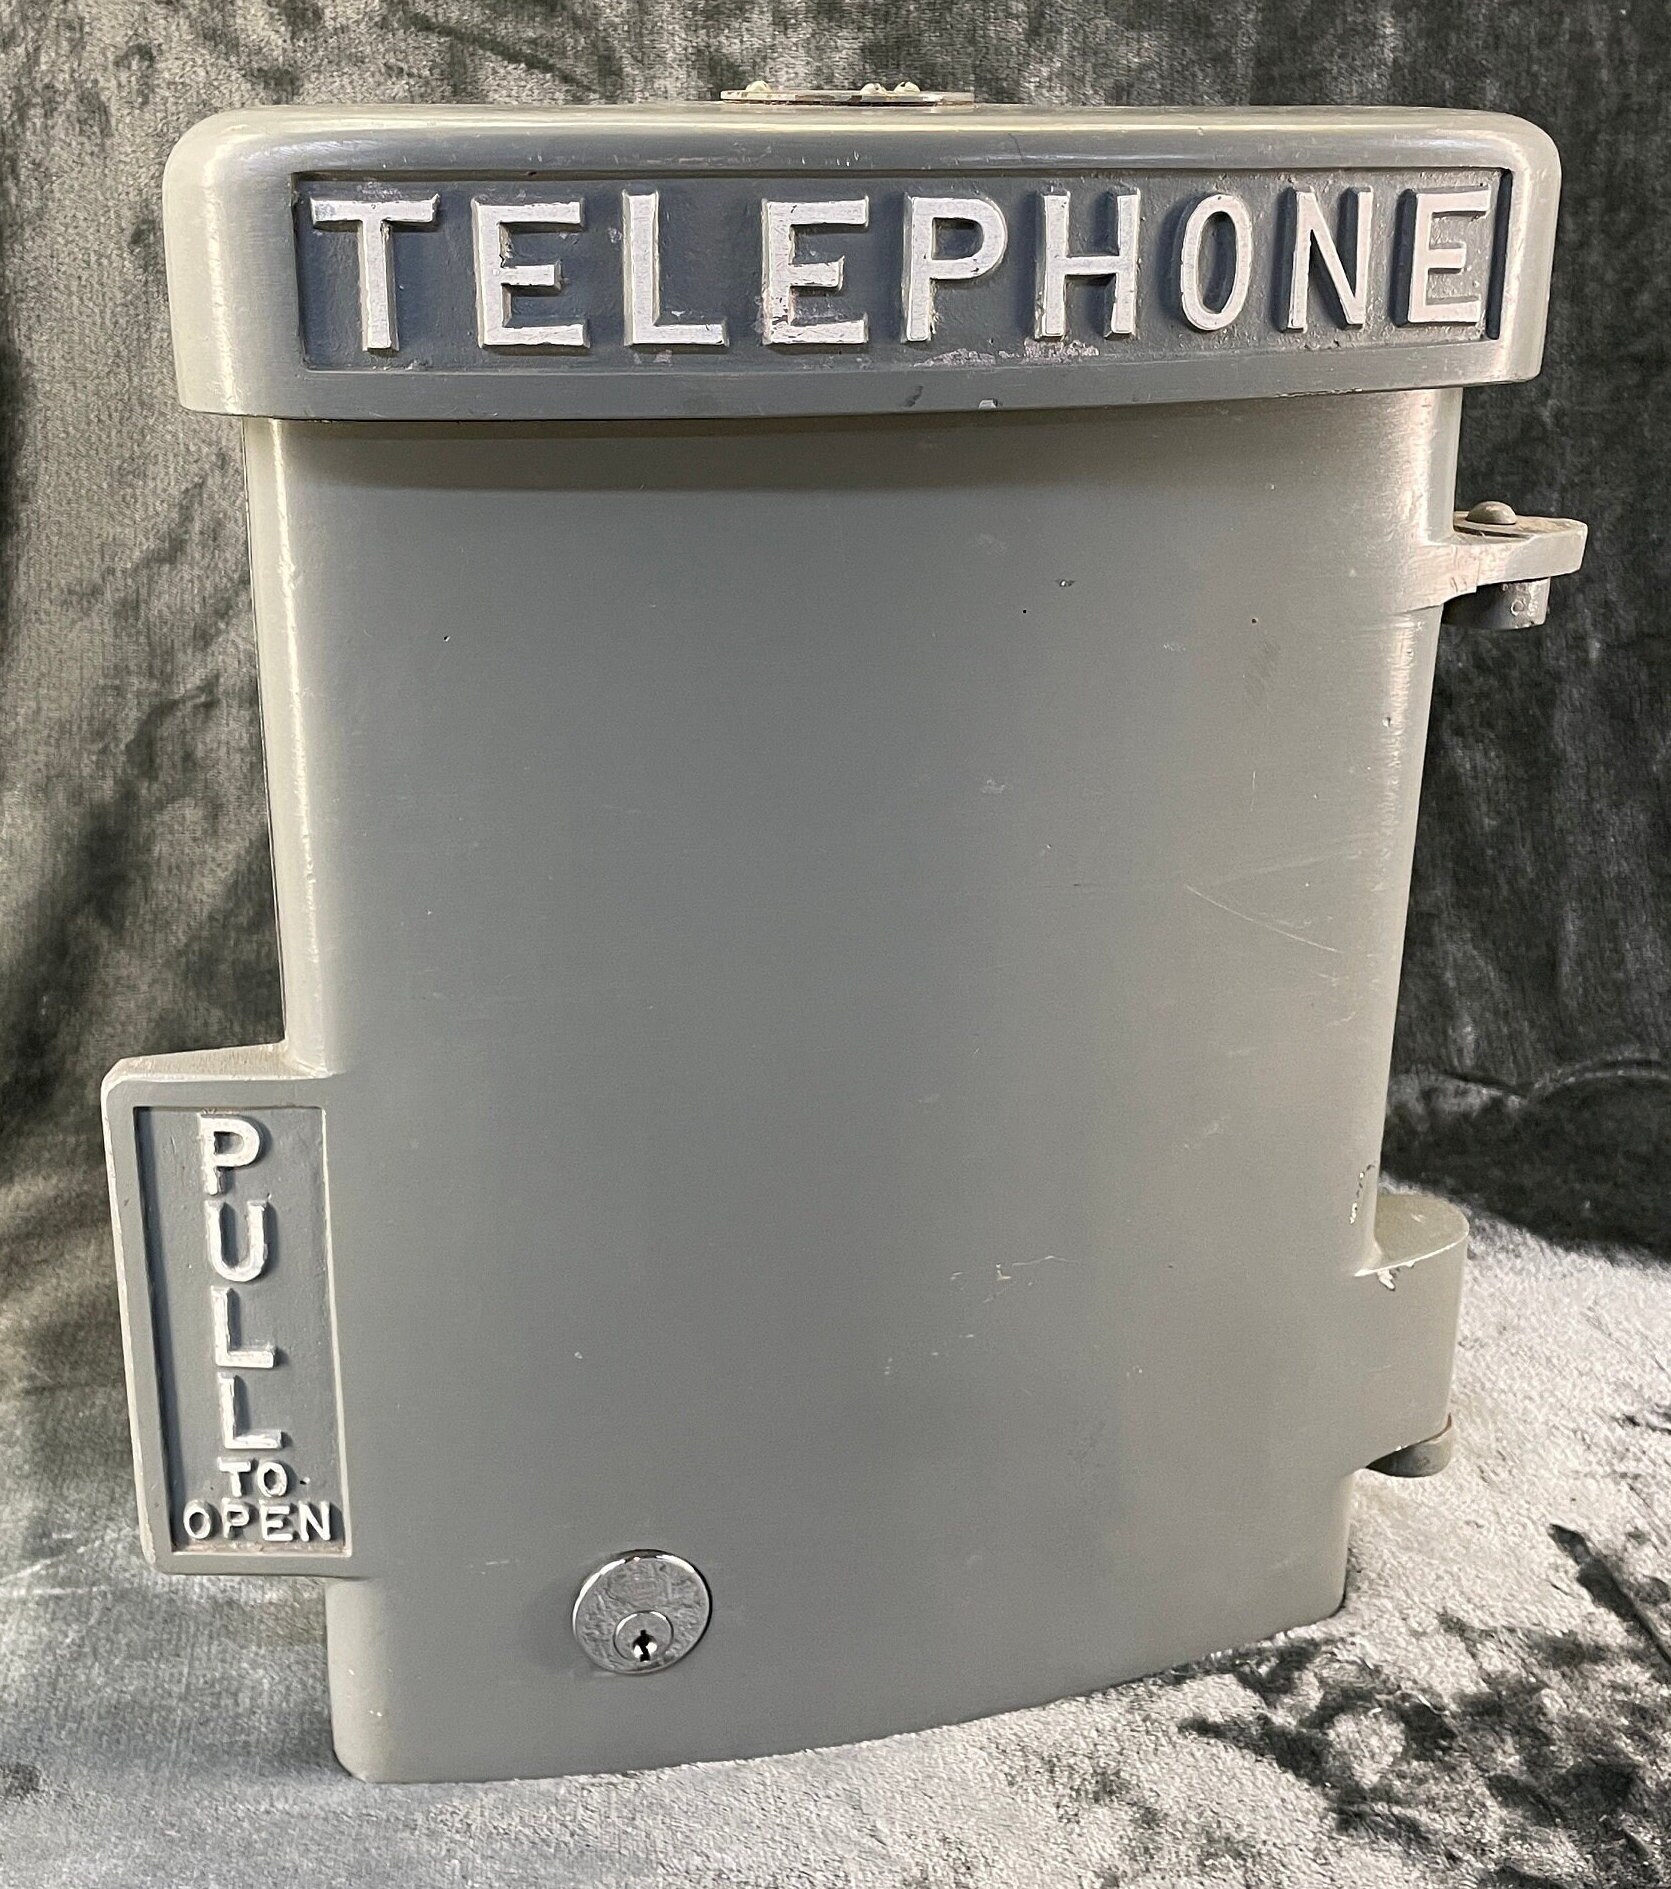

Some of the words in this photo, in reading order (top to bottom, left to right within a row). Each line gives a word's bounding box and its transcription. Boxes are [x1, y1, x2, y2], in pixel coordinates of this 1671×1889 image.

[310, 186, 1490, 351] TELEPHONE
[198, 1113, 283, 1449] PULL
[183, 1499, 332, 1543] OPEN
[217, 1457, 288, 1498] TO
